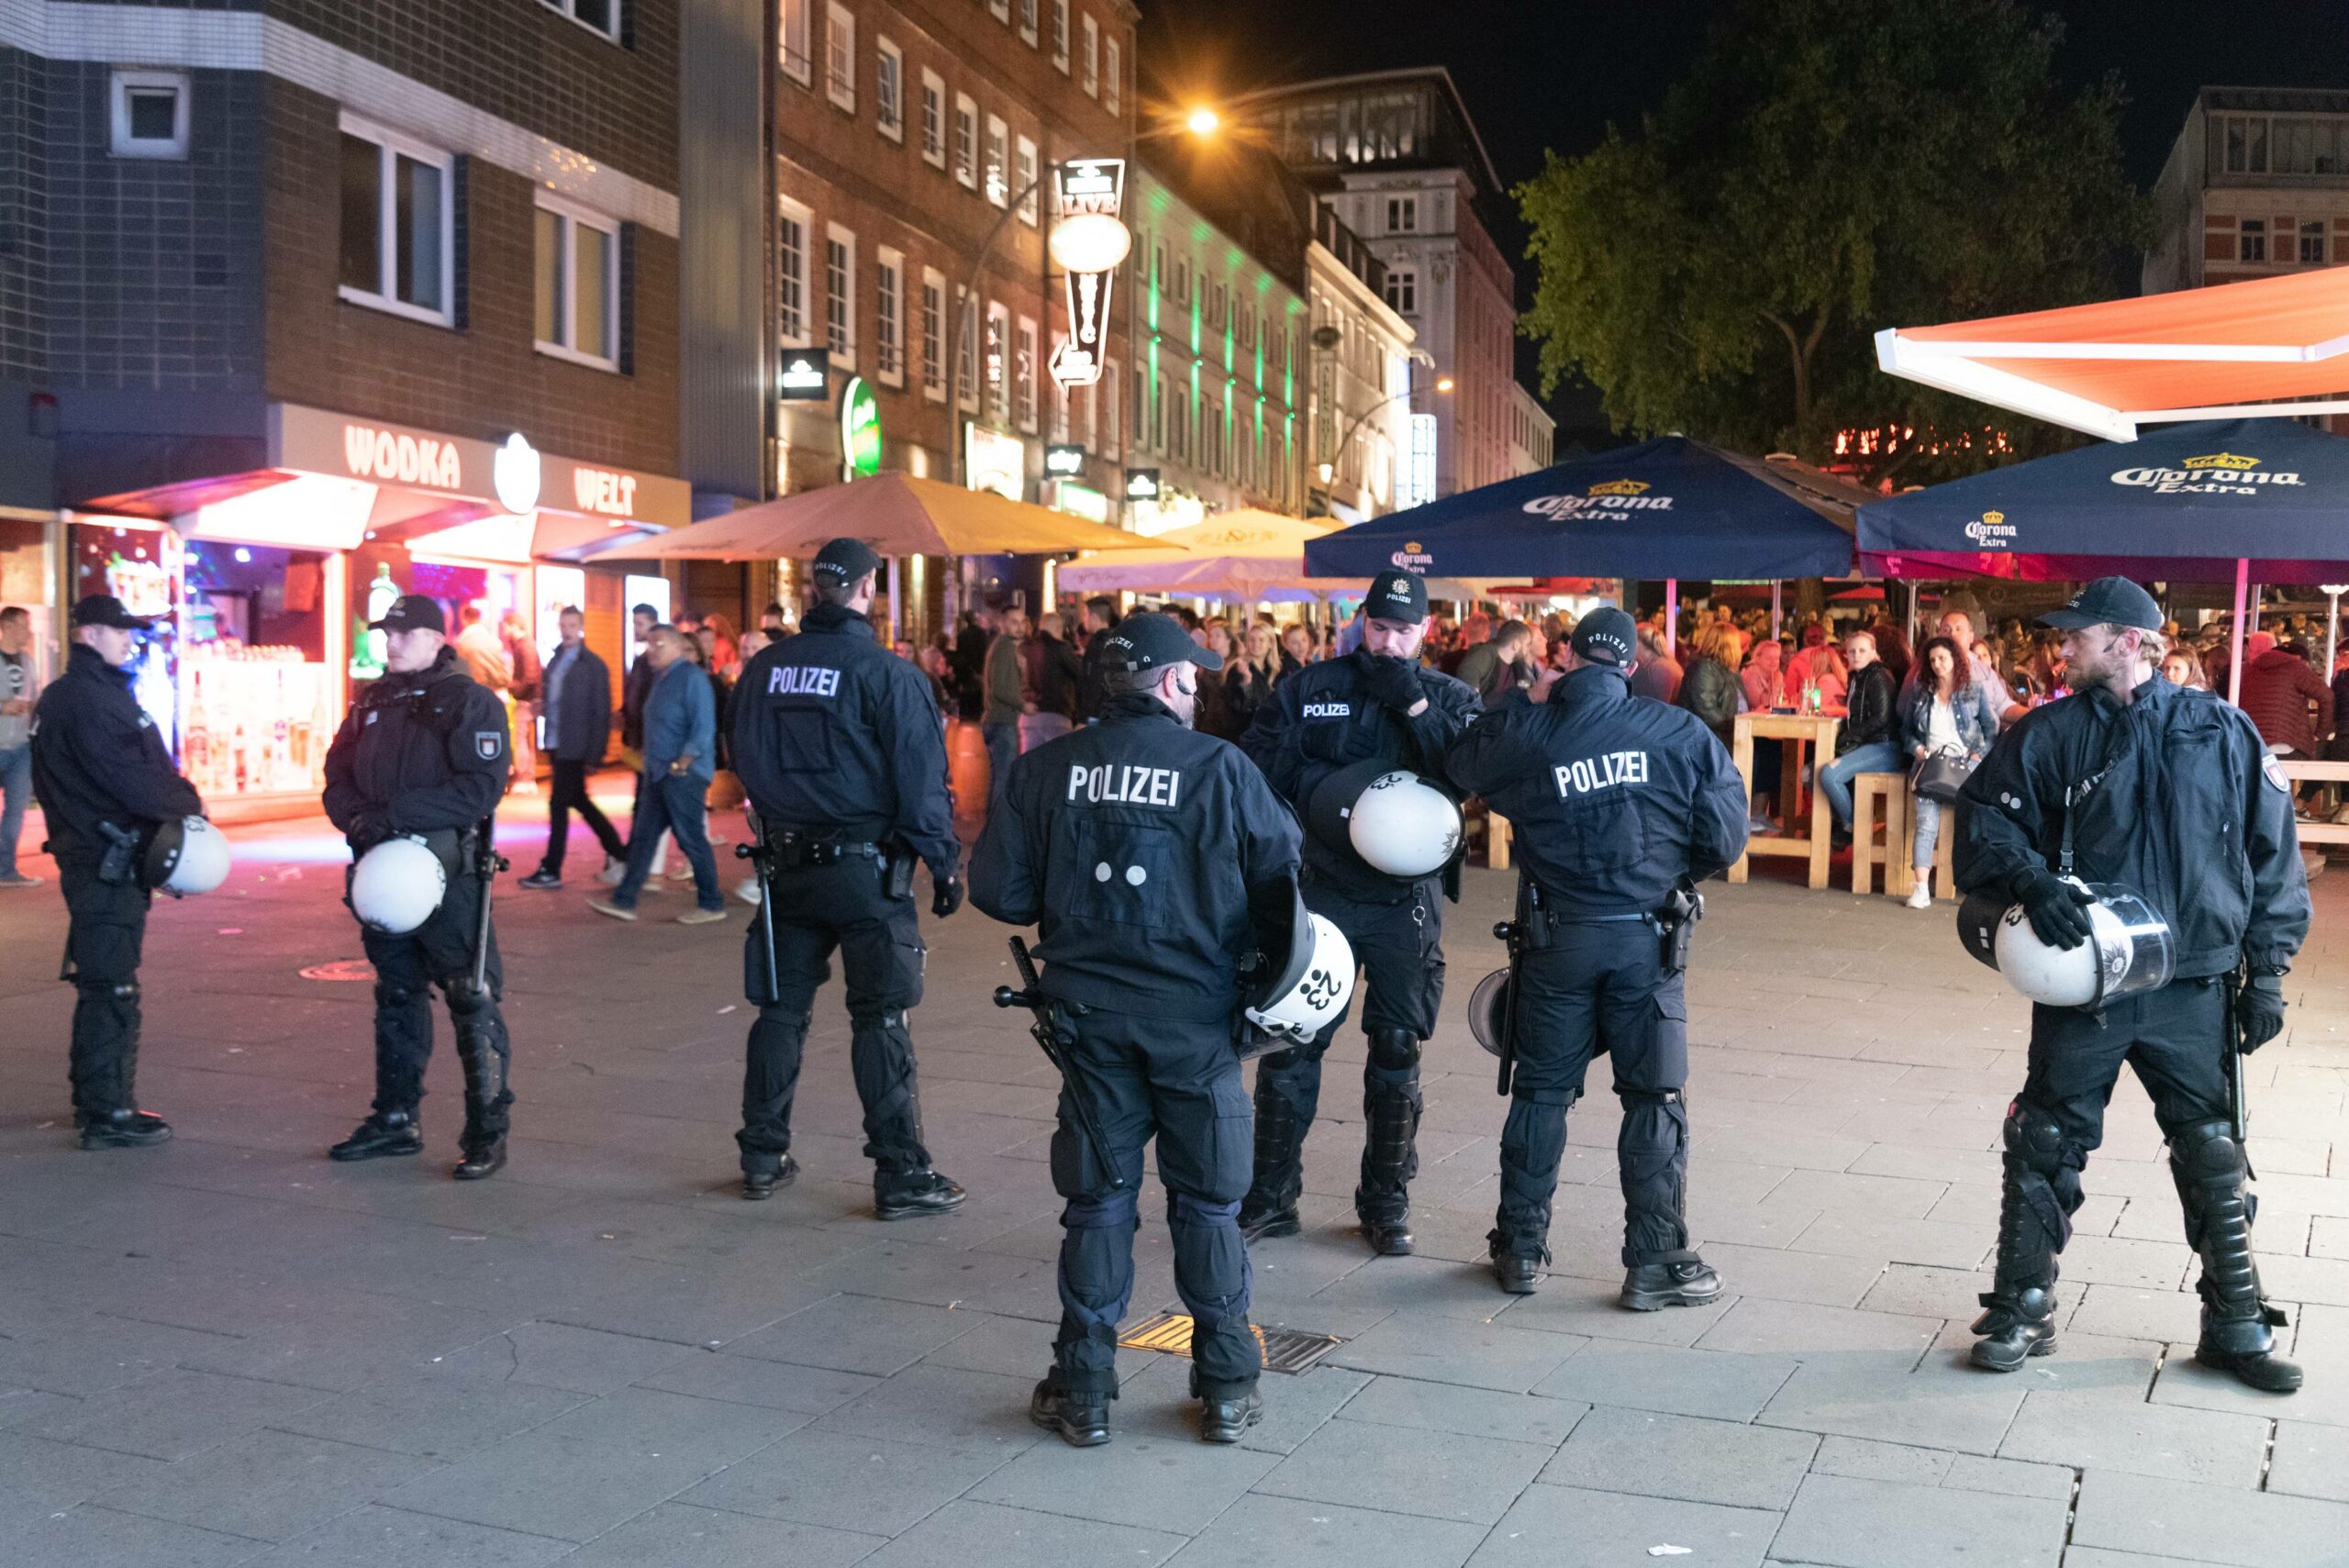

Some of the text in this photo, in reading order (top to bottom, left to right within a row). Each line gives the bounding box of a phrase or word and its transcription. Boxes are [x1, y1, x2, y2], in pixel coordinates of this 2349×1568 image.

[1062, 193, 1118, 215] LIVE
[345, 425, 637, 516] WODKA WELT
[2110, 467, 2301, 488] Corona
[2154, 482, 2257, 495] Extra
[1522, 495, 1674, 515] Corona
[1549, 509, 1631, 521] Extra
[1965, 520, 2018, 540] Corona
[1979, 536, 2008, 548] Extra
[1391, 551, 1433, 567] Corona
[1386, 593, 1411, 605] POLIZEI
[1588, 633, 1629, 654] POLIZEI
[768, 666, 841, 697] POLIZEI
[1067, 763, 1181, 807] POLIZEI
[1554, 751, 1649, 798] POLIZEI
[1306, 970, 1341, 1011] 23
